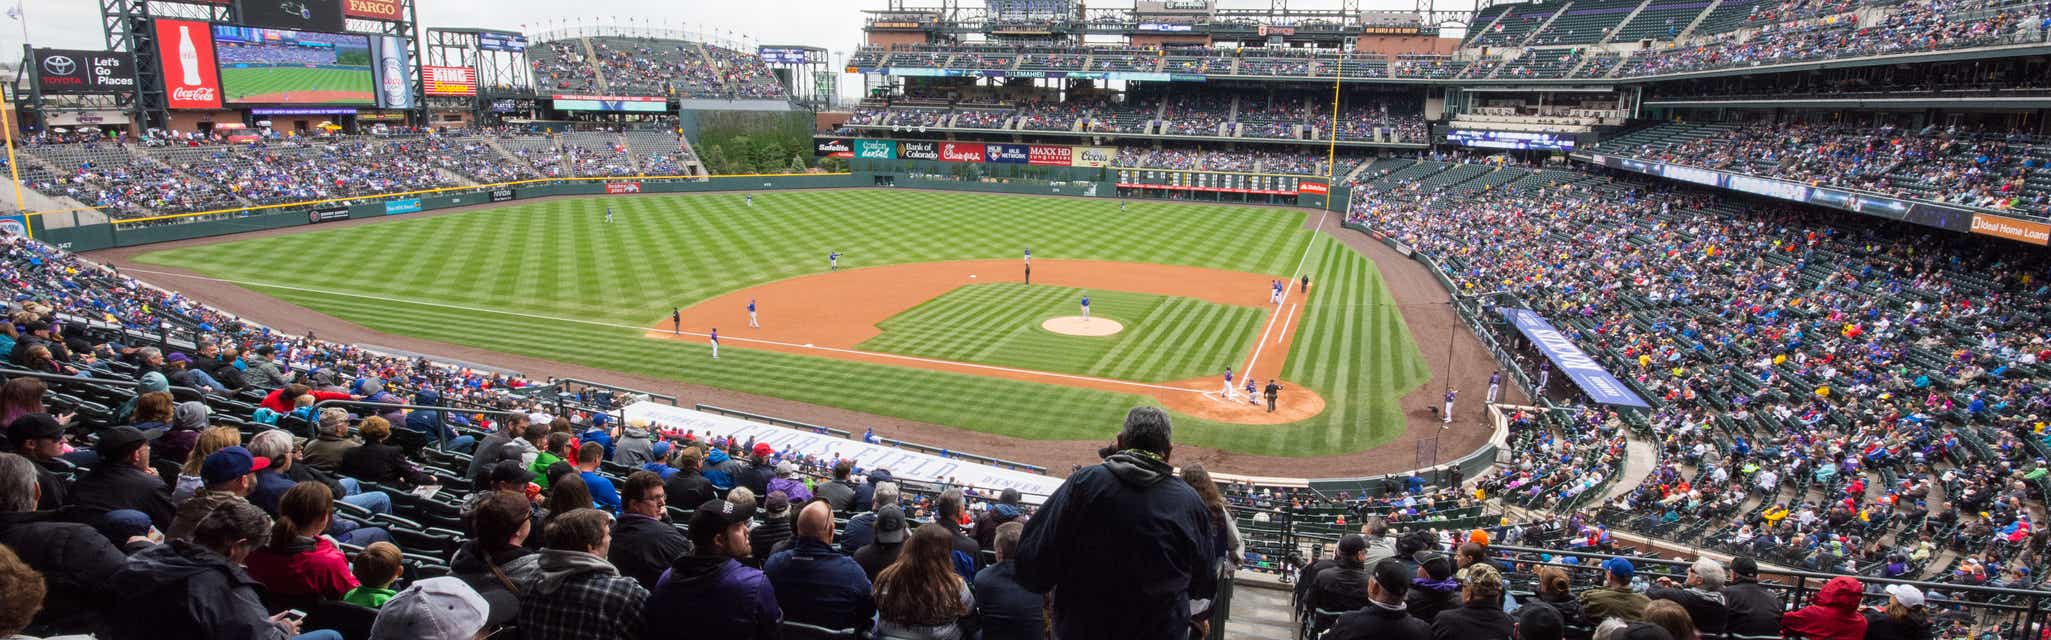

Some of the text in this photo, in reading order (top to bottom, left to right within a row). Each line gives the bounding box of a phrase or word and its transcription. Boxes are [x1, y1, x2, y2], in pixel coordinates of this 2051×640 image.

[351, 0, 396, 15] FARGO
[94, 57, 119, 67] Let's
[95, 67, 111, 76] Go
[42, 76, 82, 84] TOYOTA
[98, 76, 134, 85] Places
[173, 87, 215, 101] Coca-Cola
[818, 143, 849, 152] Safelite
[906, 143, 933, 151] Bank of
[1029, 146, 1072, 156] MAXX HD
[906, 150, 938, 159] Colorado
[1080, 150, 1108, 162] Coors
[1980, 220, 2049, 240] Ideal Home Loans
